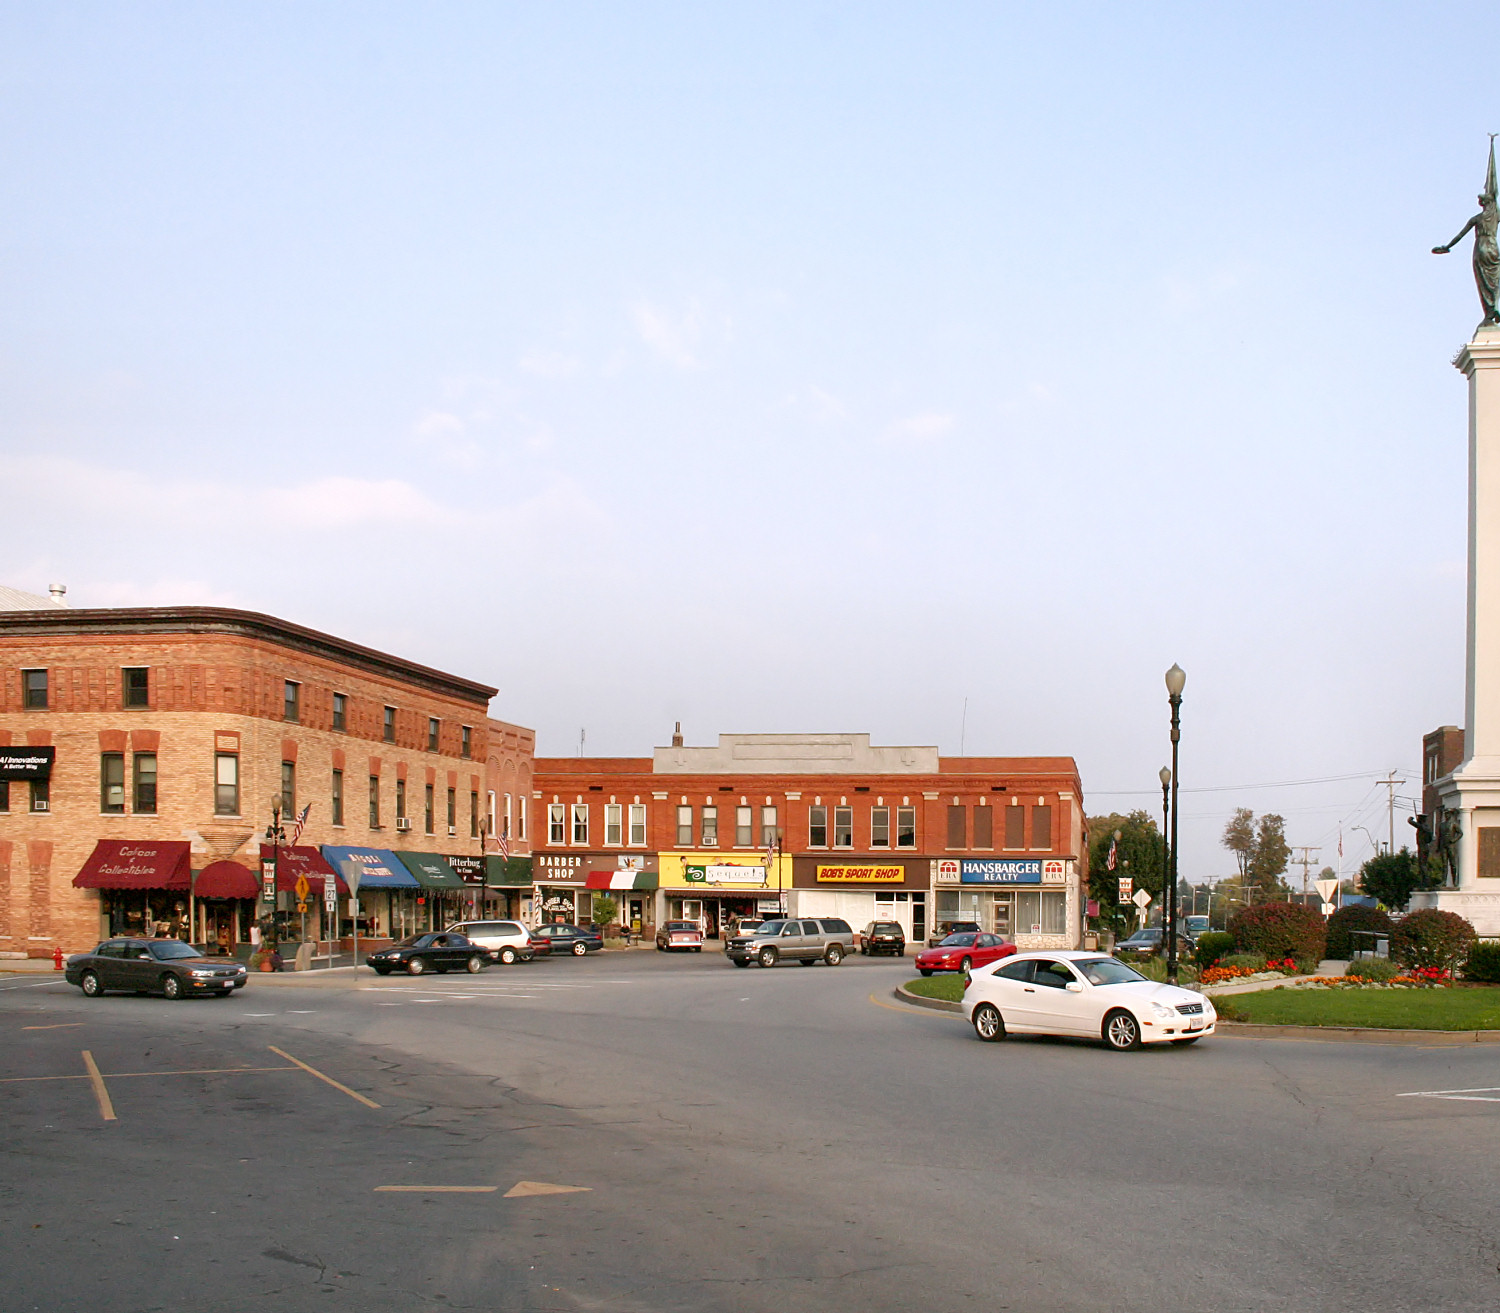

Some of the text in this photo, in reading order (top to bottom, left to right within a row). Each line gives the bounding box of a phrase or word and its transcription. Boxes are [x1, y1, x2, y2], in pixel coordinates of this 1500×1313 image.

[8, 756, 48, 764] Innovations
[449, 856, 481, 869] Jitterbug
[539, 856, 581, 867] BARBER
[98, 863, 156, 876] Collectibles
[547, 868, 574, 879] SHOP
[820, 868, 900, 878] BOB'S SPORT SHOP
[963, 862, 1040, 874] HANSBARGER
[984, 873, 1019, 881] REALTY
[326, 889, 336, 899] 127
